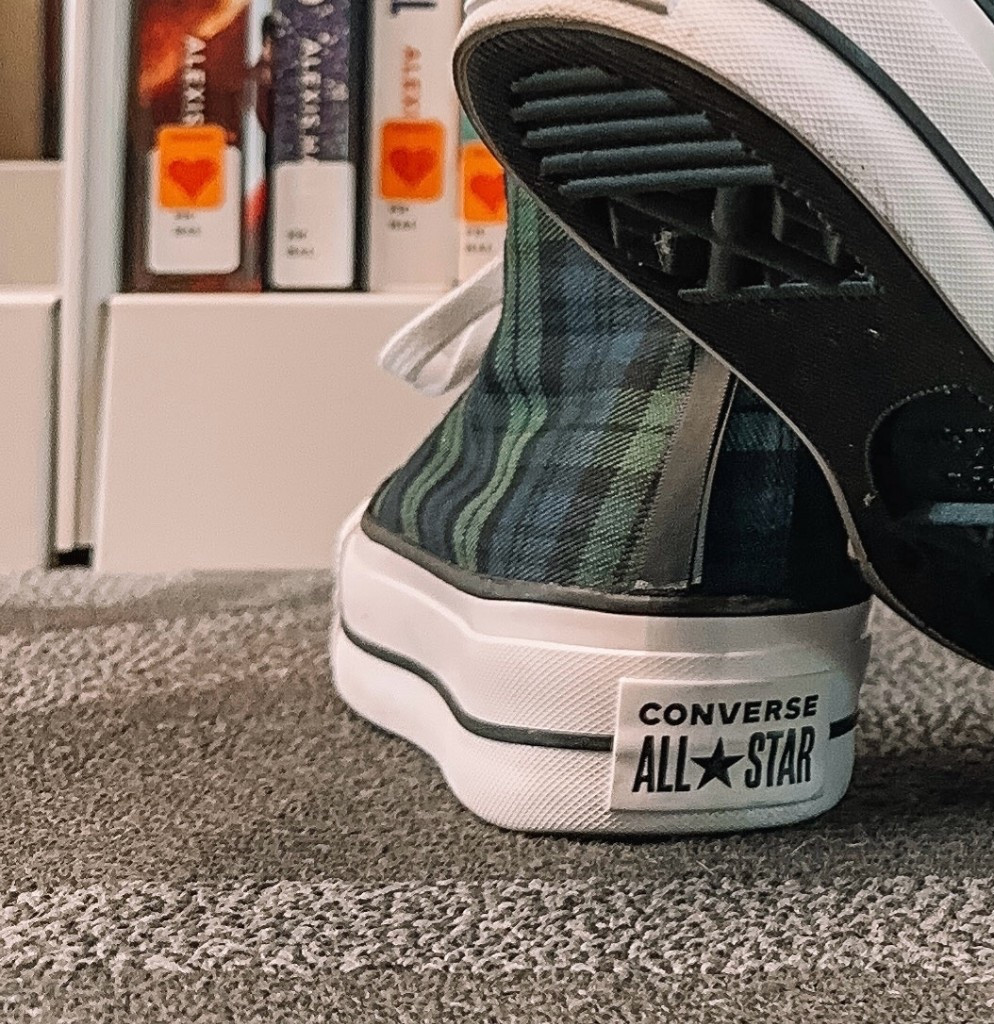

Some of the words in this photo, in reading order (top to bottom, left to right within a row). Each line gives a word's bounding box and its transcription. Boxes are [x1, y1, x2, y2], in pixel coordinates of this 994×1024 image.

[181, 34, 207, 125] ALEXIS
[300, 36, 323, 130] ALEXIS
[638, 694, 820, 726] CONVERSE
[631, 735, 691, 793] ALL
[744, 726, 816, 788] STAR
